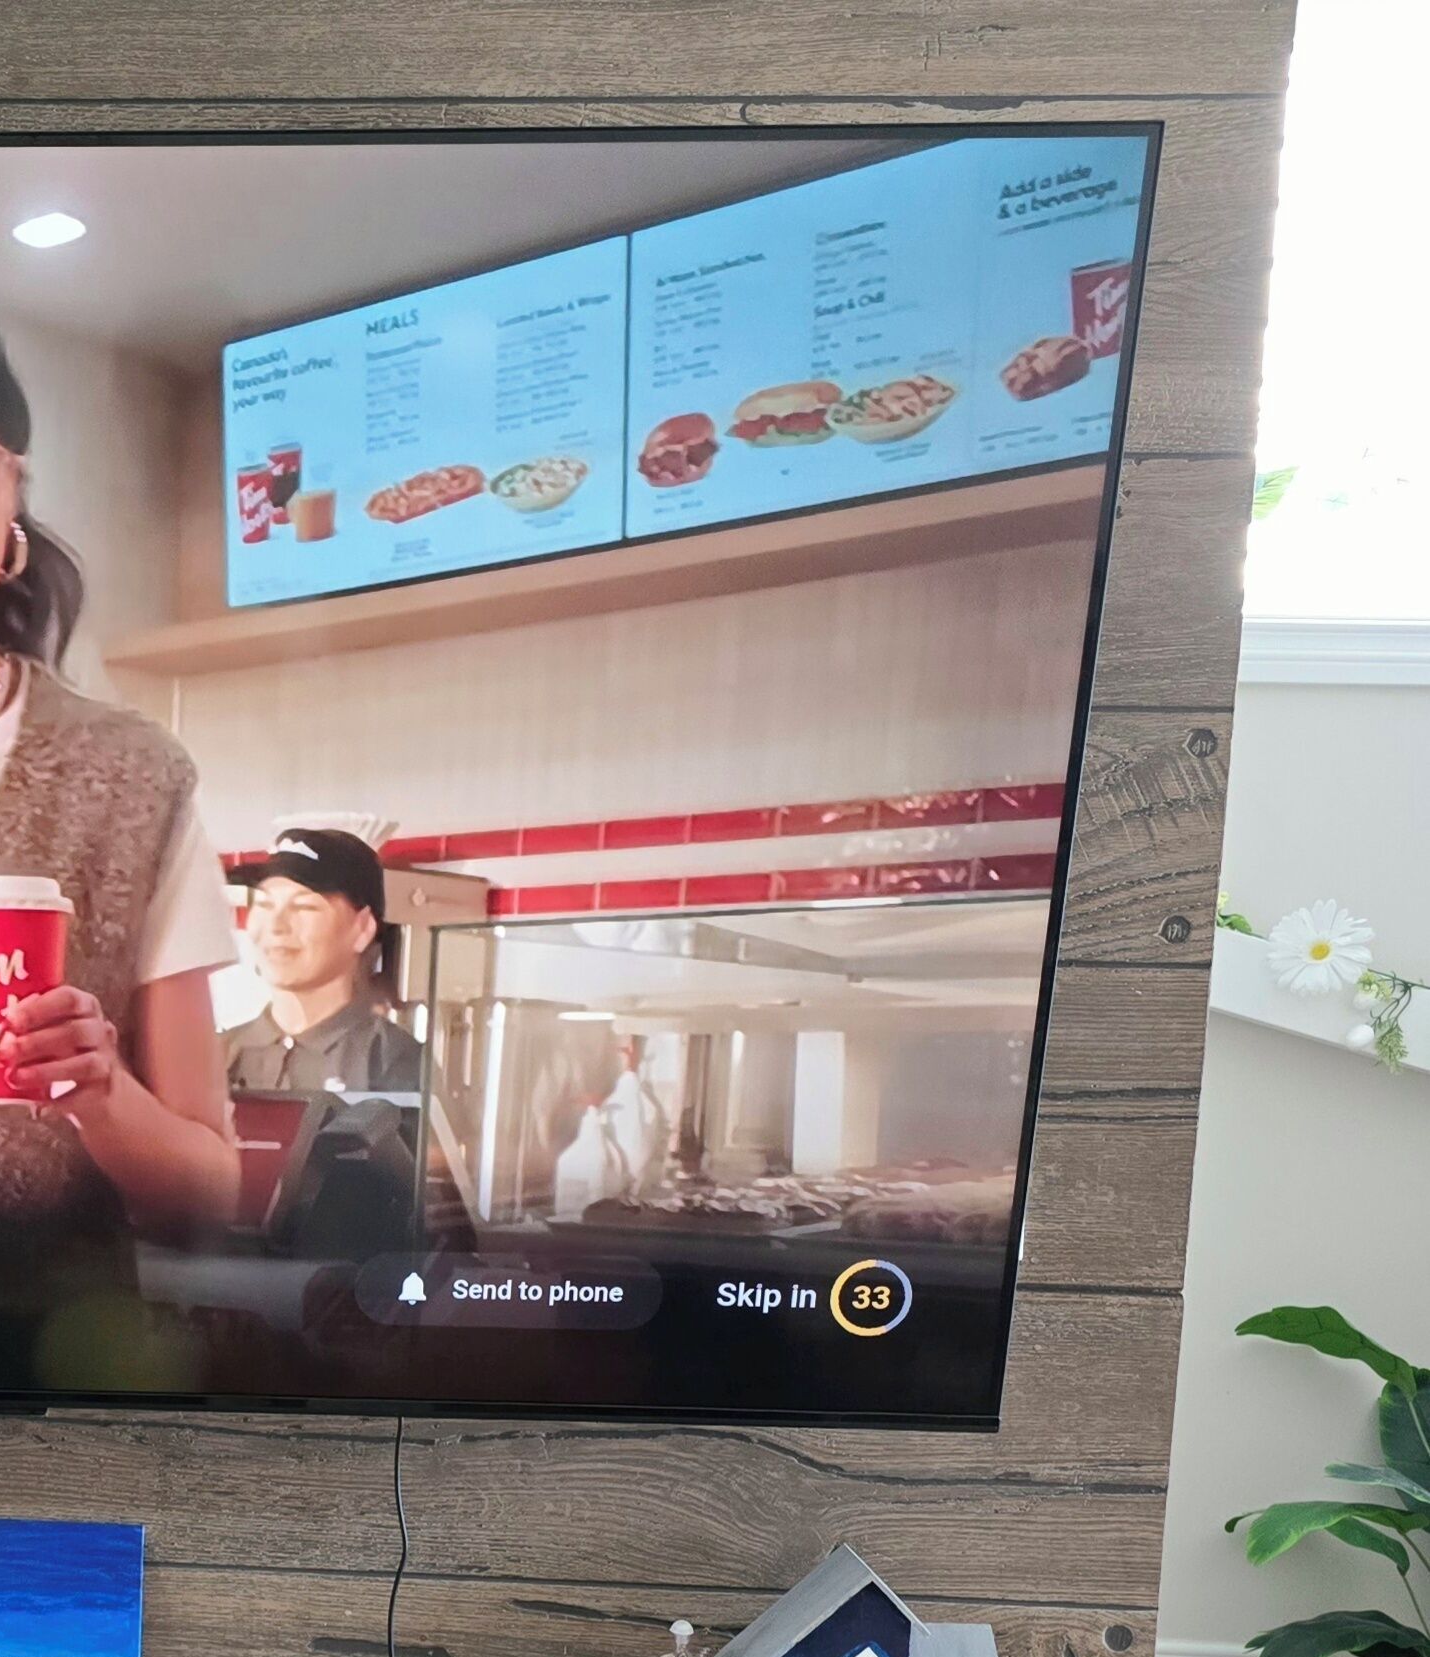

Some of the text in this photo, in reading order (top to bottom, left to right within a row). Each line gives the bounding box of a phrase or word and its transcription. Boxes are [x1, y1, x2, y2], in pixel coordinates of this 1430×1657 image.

[365, 308, 421, 337] MEALS
[451, 1277, 892, 1315] Send to phone Skip in 33
